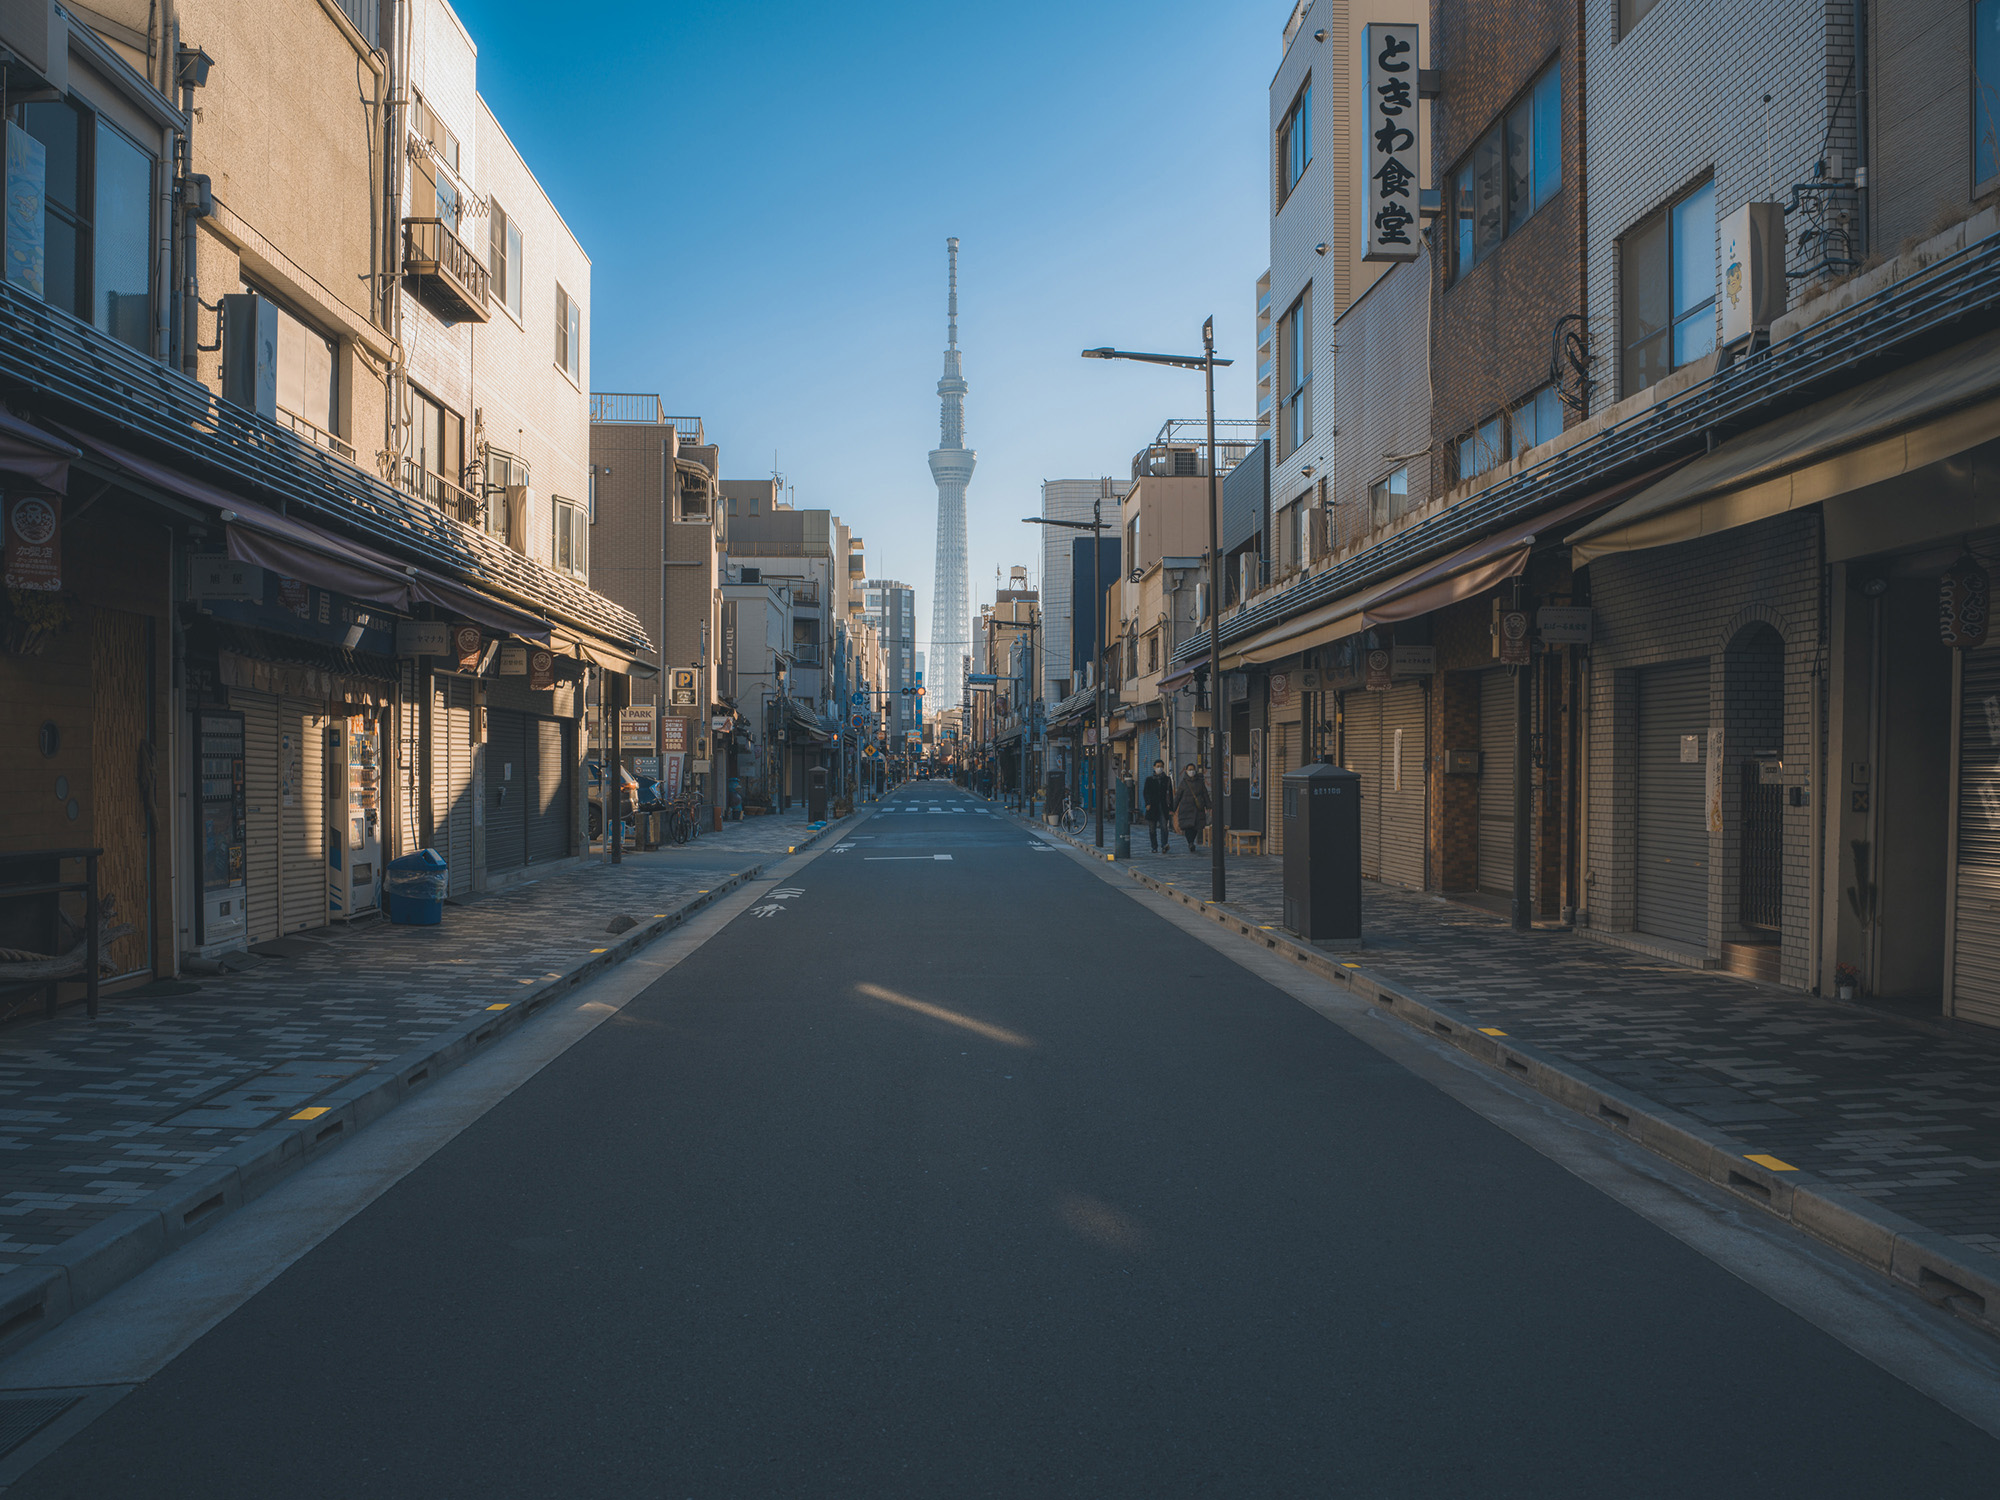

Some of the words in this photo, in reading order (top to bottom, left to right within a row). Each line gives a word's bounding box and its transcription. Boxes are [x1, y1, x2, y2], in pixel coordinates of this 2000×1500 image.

[1373, 35, 1415, 246] ときわ食堂
[15, 546, 53, 558] 加盟店
[416, 635, 444, 644] ヤマナカ
[678, 672, 691, 687] P
[628, 710, 652, 718] PARK
